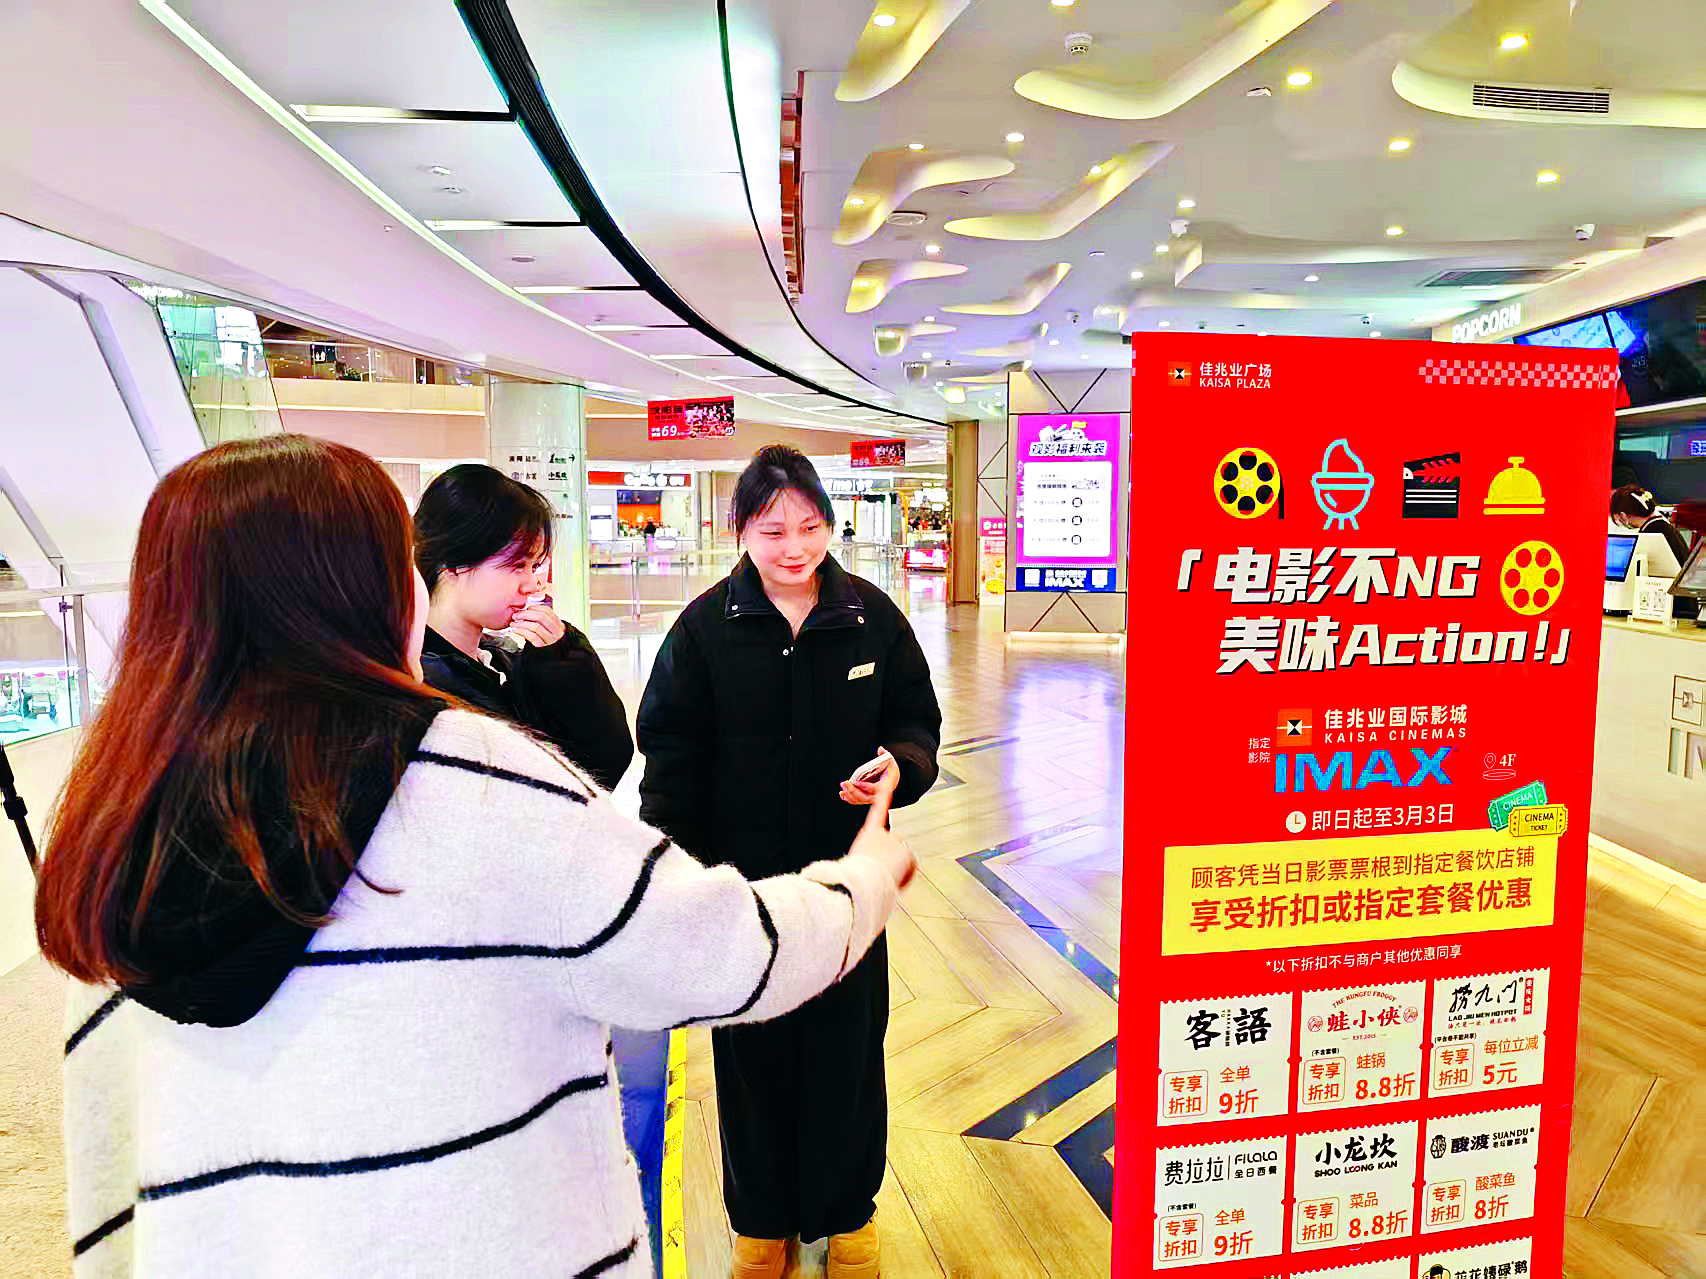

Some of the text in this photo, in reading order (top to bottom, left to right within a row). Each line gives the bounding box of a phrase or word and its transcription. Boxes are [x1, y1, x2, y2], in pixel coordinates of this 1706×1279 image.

[1451, 303, 1521, 344] POPCORN
[1199, 361, 1273, 379] 佳兆业广场
[1199, 378, 1271, 389] KAISA PLAZA
[661, 425, 678, 436] 69
[1044, 576, 1086, 588] IMAX
[1324, 704, 1468, 730] 佳兆业国际影城
[1248, 737, 1271, 749] 指定
[1324, 727, 1467, 744] KAISA CINEMAS
[1248, 751, 1271, 764] 影院
[1499, 753, 1516, 767] 4F
[1274, 745, 1454, 794] IMAX
[1502, 790, 1534, 811] CINEMA
[1311, 803, 1455, 833] 即日起至3月3日
[1524, 812, 1555, 822] CINEMA
[1191, 845, 1535, 890] 顾客凭当日影票票根到指定餐饮店铺
[1189, 877, 1533, 933] 享受折扣或指定套餐优惠
[1448, 980, 1518, 1014] 捞九门
[1326, 1006, 1402, 1033] 蛙小侠
[1484, 1035, 1539, 1055] 每位立减
[1356, 1052, 1386, 1069] 蛙锅
[1440, 1048, 1469, 1065] 专享
[1220, 1065, 1251, 1083] 全单
[1309, 1062, 1341, 1080] 专享
[1438, 1068, 1468, 1087] 折扣
[1482, 1061, 1518, 1085] 5元
[1169, 1075, 1202, 1093] 专享
[1308, 1083, 1339, 1101] 折扣
[1355, 1072, 1416, 1100] 8.8折
[1168, 1096, 1202, 1115] 折扣
[1219, 1088, 1259, 1114] 9折
[1451, 1133, 1490, 1154] 酸渡
[1492, 1128, 1529, 1141] SUANDU
[1314, 1133, 1398, 1166] 小龙坎
[1164, 1156, 1224, 1187] 费拉拉
[1314, 1160, 1398, 1178] SHOO LOONG KAN
[1475, 1172, 1516, 1192] 酸菜鱼
[1349, 1191, 1379, 1209] 菜品
[1432, 1185, 1461, 1202] 专享
[1303, 1202, 1334, 1220] 专享
[1431, 1204, 1460, 1222] 折扣
[1474, 1194, 1510, 1219] 8折
[1214, 1208, 1246, 1226] 全单
[1348, 1209, 1408, 1239] 8.8折
[1165, 1219, 1198, 1237] 专享
[1302, 1222, 1333, 1241] 折扣
[1164, 1239, 1197, 1258] 折扣
[1214, 1230, 1254, 1256] 9折
